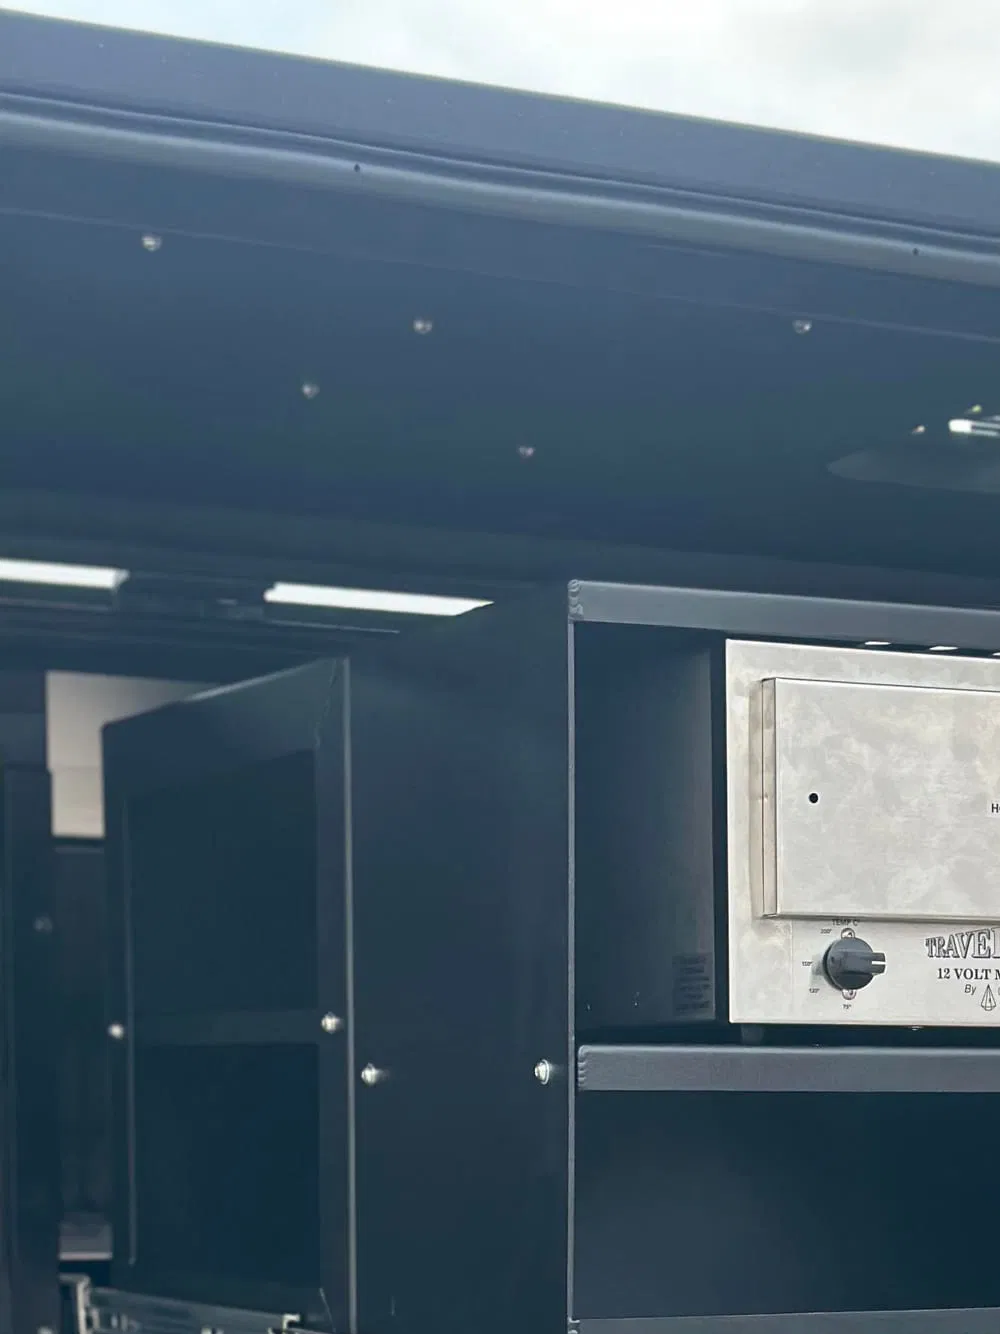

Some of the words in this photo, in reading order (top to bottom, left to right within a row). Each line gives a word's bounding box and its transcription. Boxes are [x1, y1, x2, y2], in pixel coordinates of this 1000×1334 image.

[937, 968, 950, 980] 12
[954, 968, 992, 980] VOLT
[964, 983, 977, 996] By
